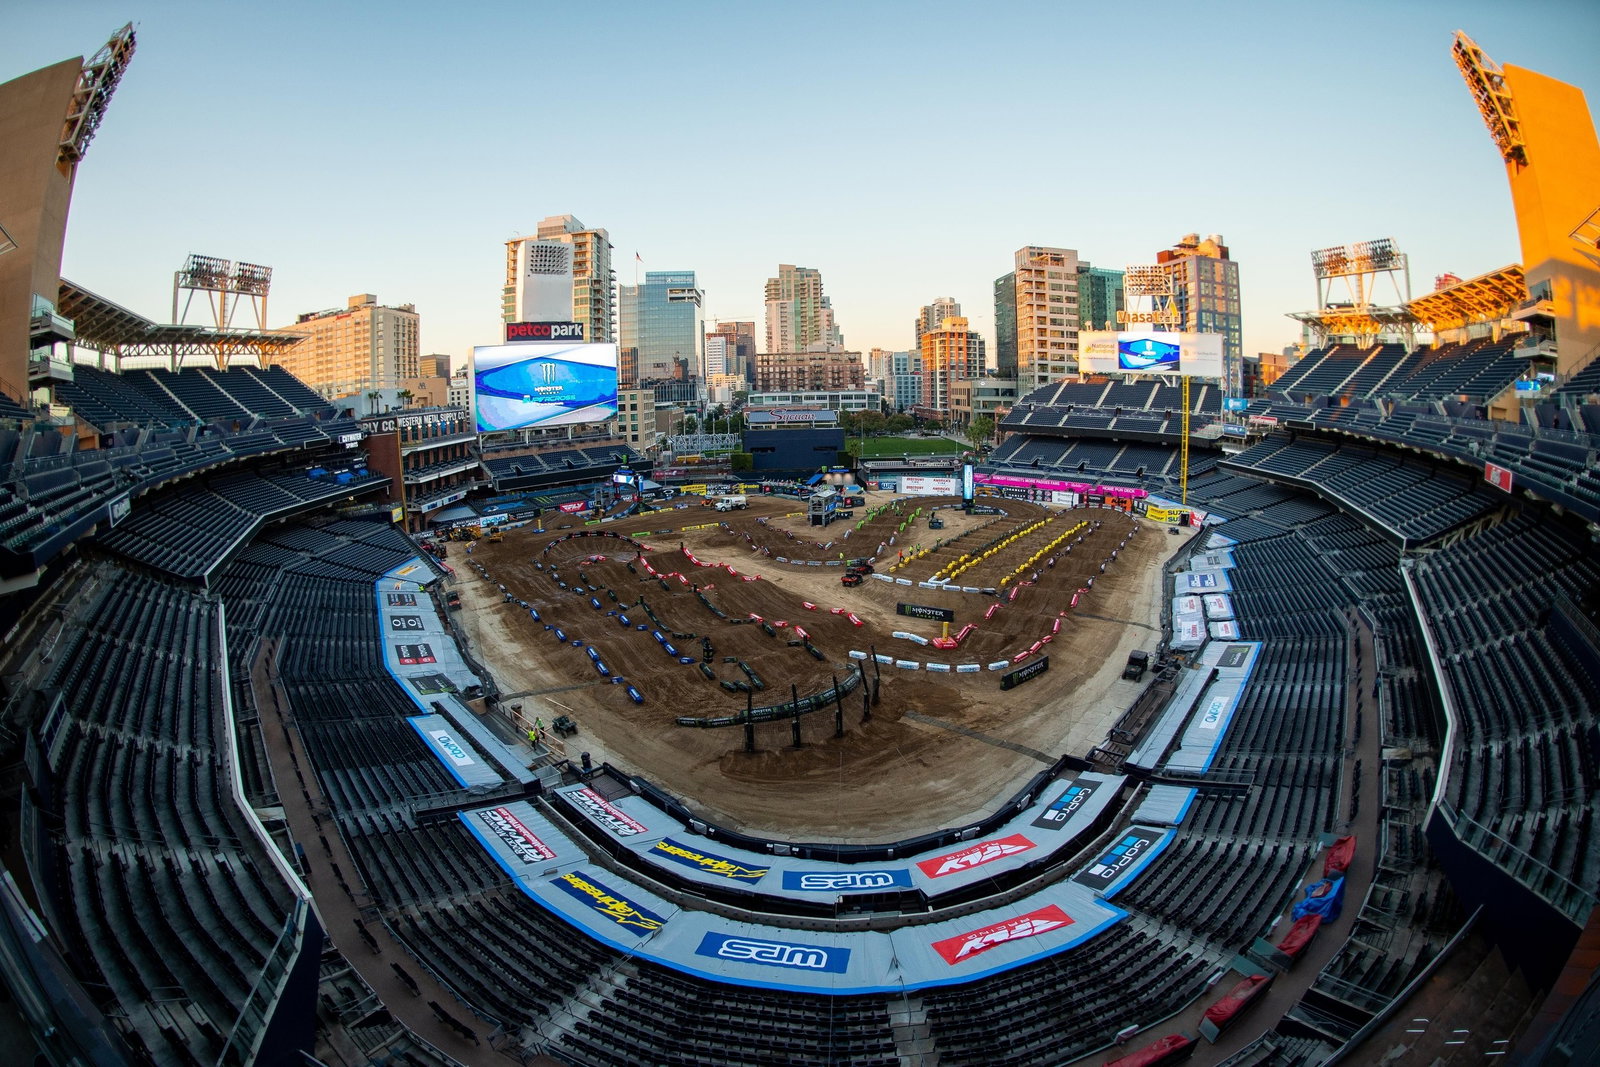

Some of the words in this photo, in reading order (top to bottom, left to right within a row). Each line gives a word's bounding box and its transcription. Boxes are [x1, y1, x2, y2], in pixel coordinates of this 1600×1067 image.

[398, 416, 422, 427] WESTERN
[424, 415, 438, 424] METAL
[440, 412, 457, 422] SUPPLY
[769, 408, 816, 422] Sycuan
[912, 607, 944, 617] MONSTER
[1018, 662, 1044, 678] MONSTER
[1054, 788, 1092, 822] GoPro
[656, 841, 730, 872] alpinestars
[934, 843, 1028, 876] FLY
[1099, 840, 1150, 879] GoPro
[561, 873, 630, 916] alpinestars
[800, 872, 894, 890] WPS
[718, 938, 828, 968] WPS
[954, 918, 1068, 962] FLY
